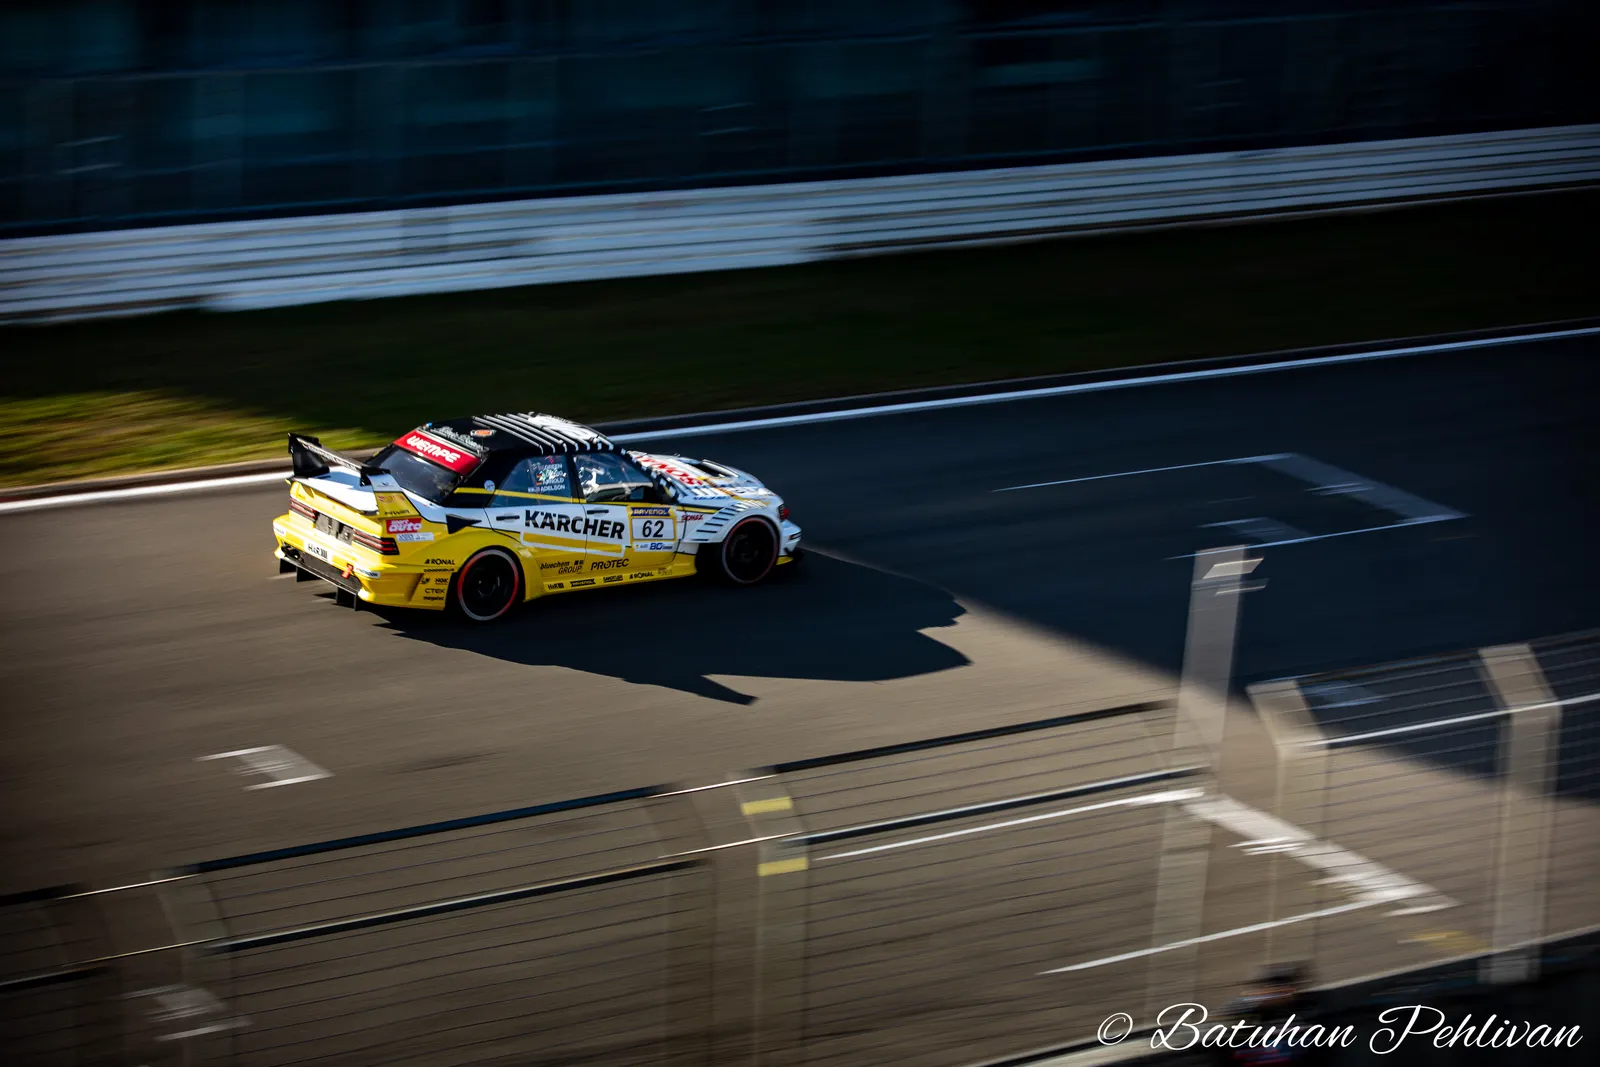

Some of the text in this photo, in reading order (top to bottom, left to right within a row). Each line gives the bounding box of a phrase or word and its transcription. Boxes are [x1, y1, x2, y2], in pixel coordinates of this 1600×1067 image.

[406, 435, 461, 464] WEMPE
[540, 484, 566, 492] ADELSON
[388, 522, 422, 533] auto
[524, 509, 625, 540] KÄRCHER
[642, 520, 664, 538] 62
[430, 558, 456, 566] RONAL
[540, 560, 570, 570] bluechem
[590, 558, 630, 571] PROTEC
[558, 565, 582, 575] GROUP
